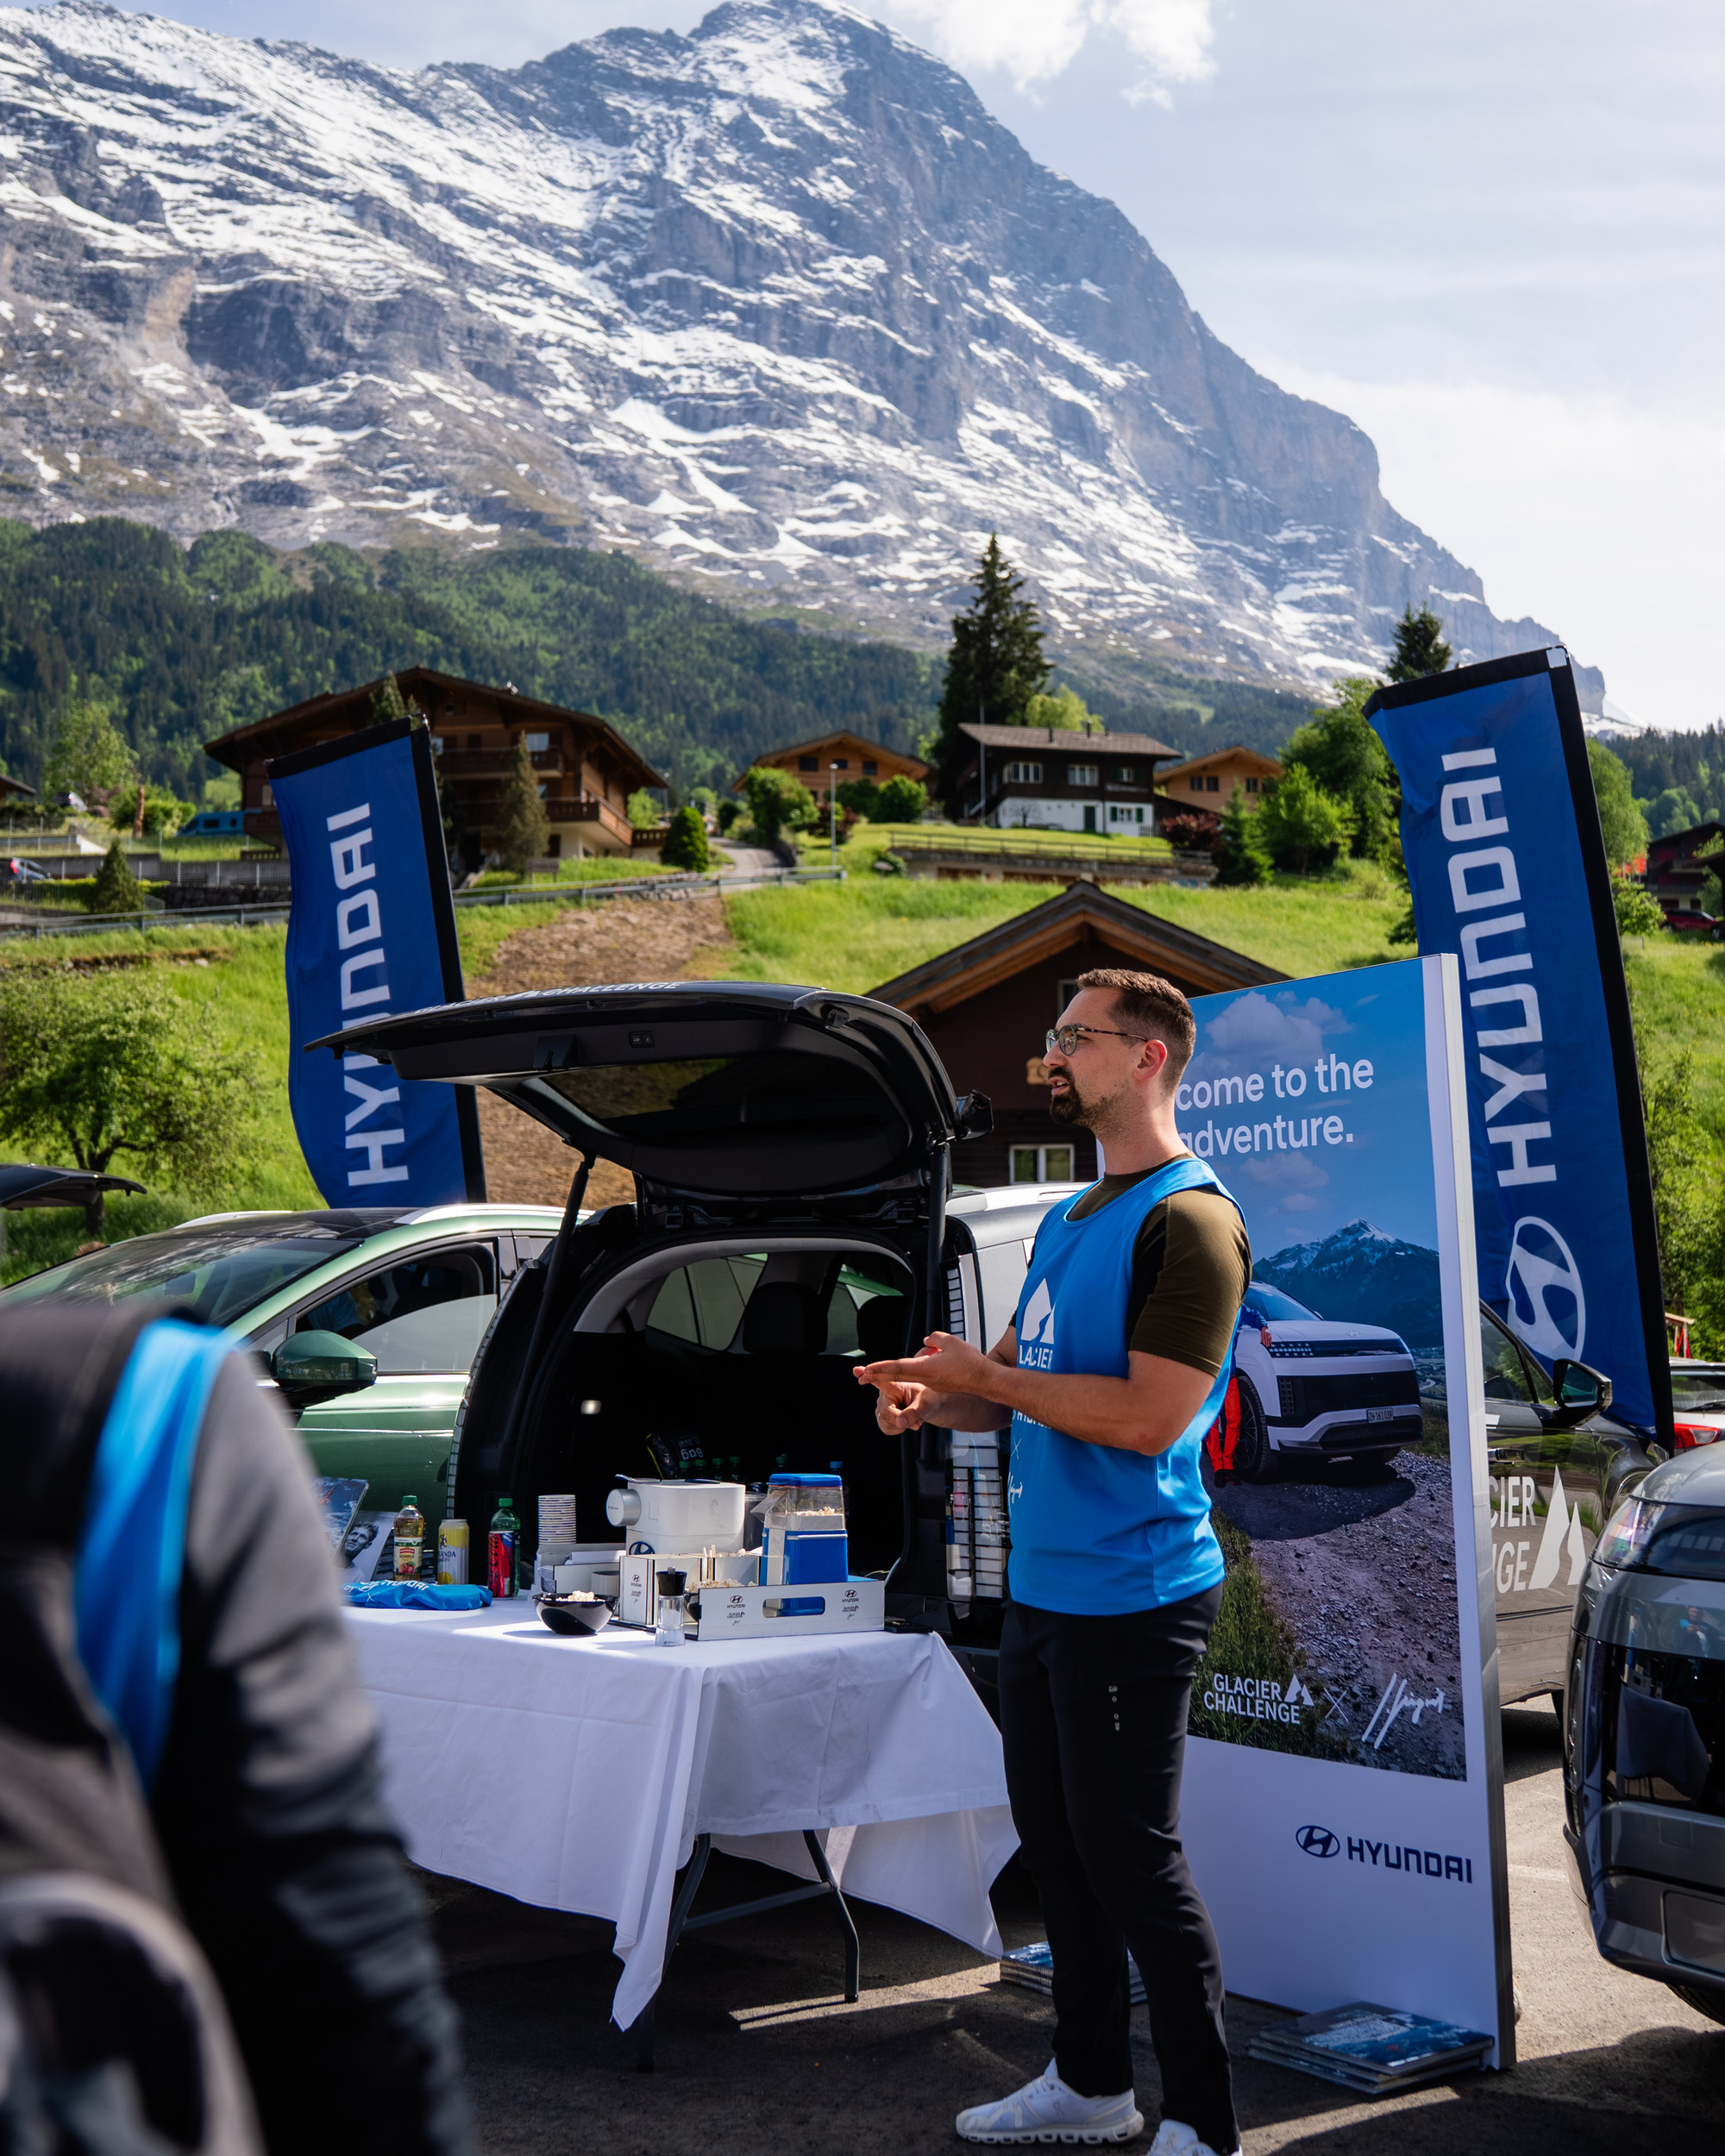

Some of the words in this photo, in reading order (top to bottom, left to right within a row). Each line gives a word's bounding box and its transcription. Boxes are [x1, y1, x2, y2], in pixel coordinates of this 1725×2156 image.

[1440, 747, 1557, 1188] HYUNDAI
[543, 981, 686, 996] CHALLENGE
[1176, 1073, 1264, 1111] come
[1271, 1064, 1307, 1098] to
[1314, 1053, 1374, 1094] the
[1019, 1344, 1053, 1369] LACIER
[1214, 1673, 1282, 1701] GLACIER
[1204, 1690, 1301, 1725] CHALLENGE
[1347, 1836, 1472, 1883] HYUNDAI
